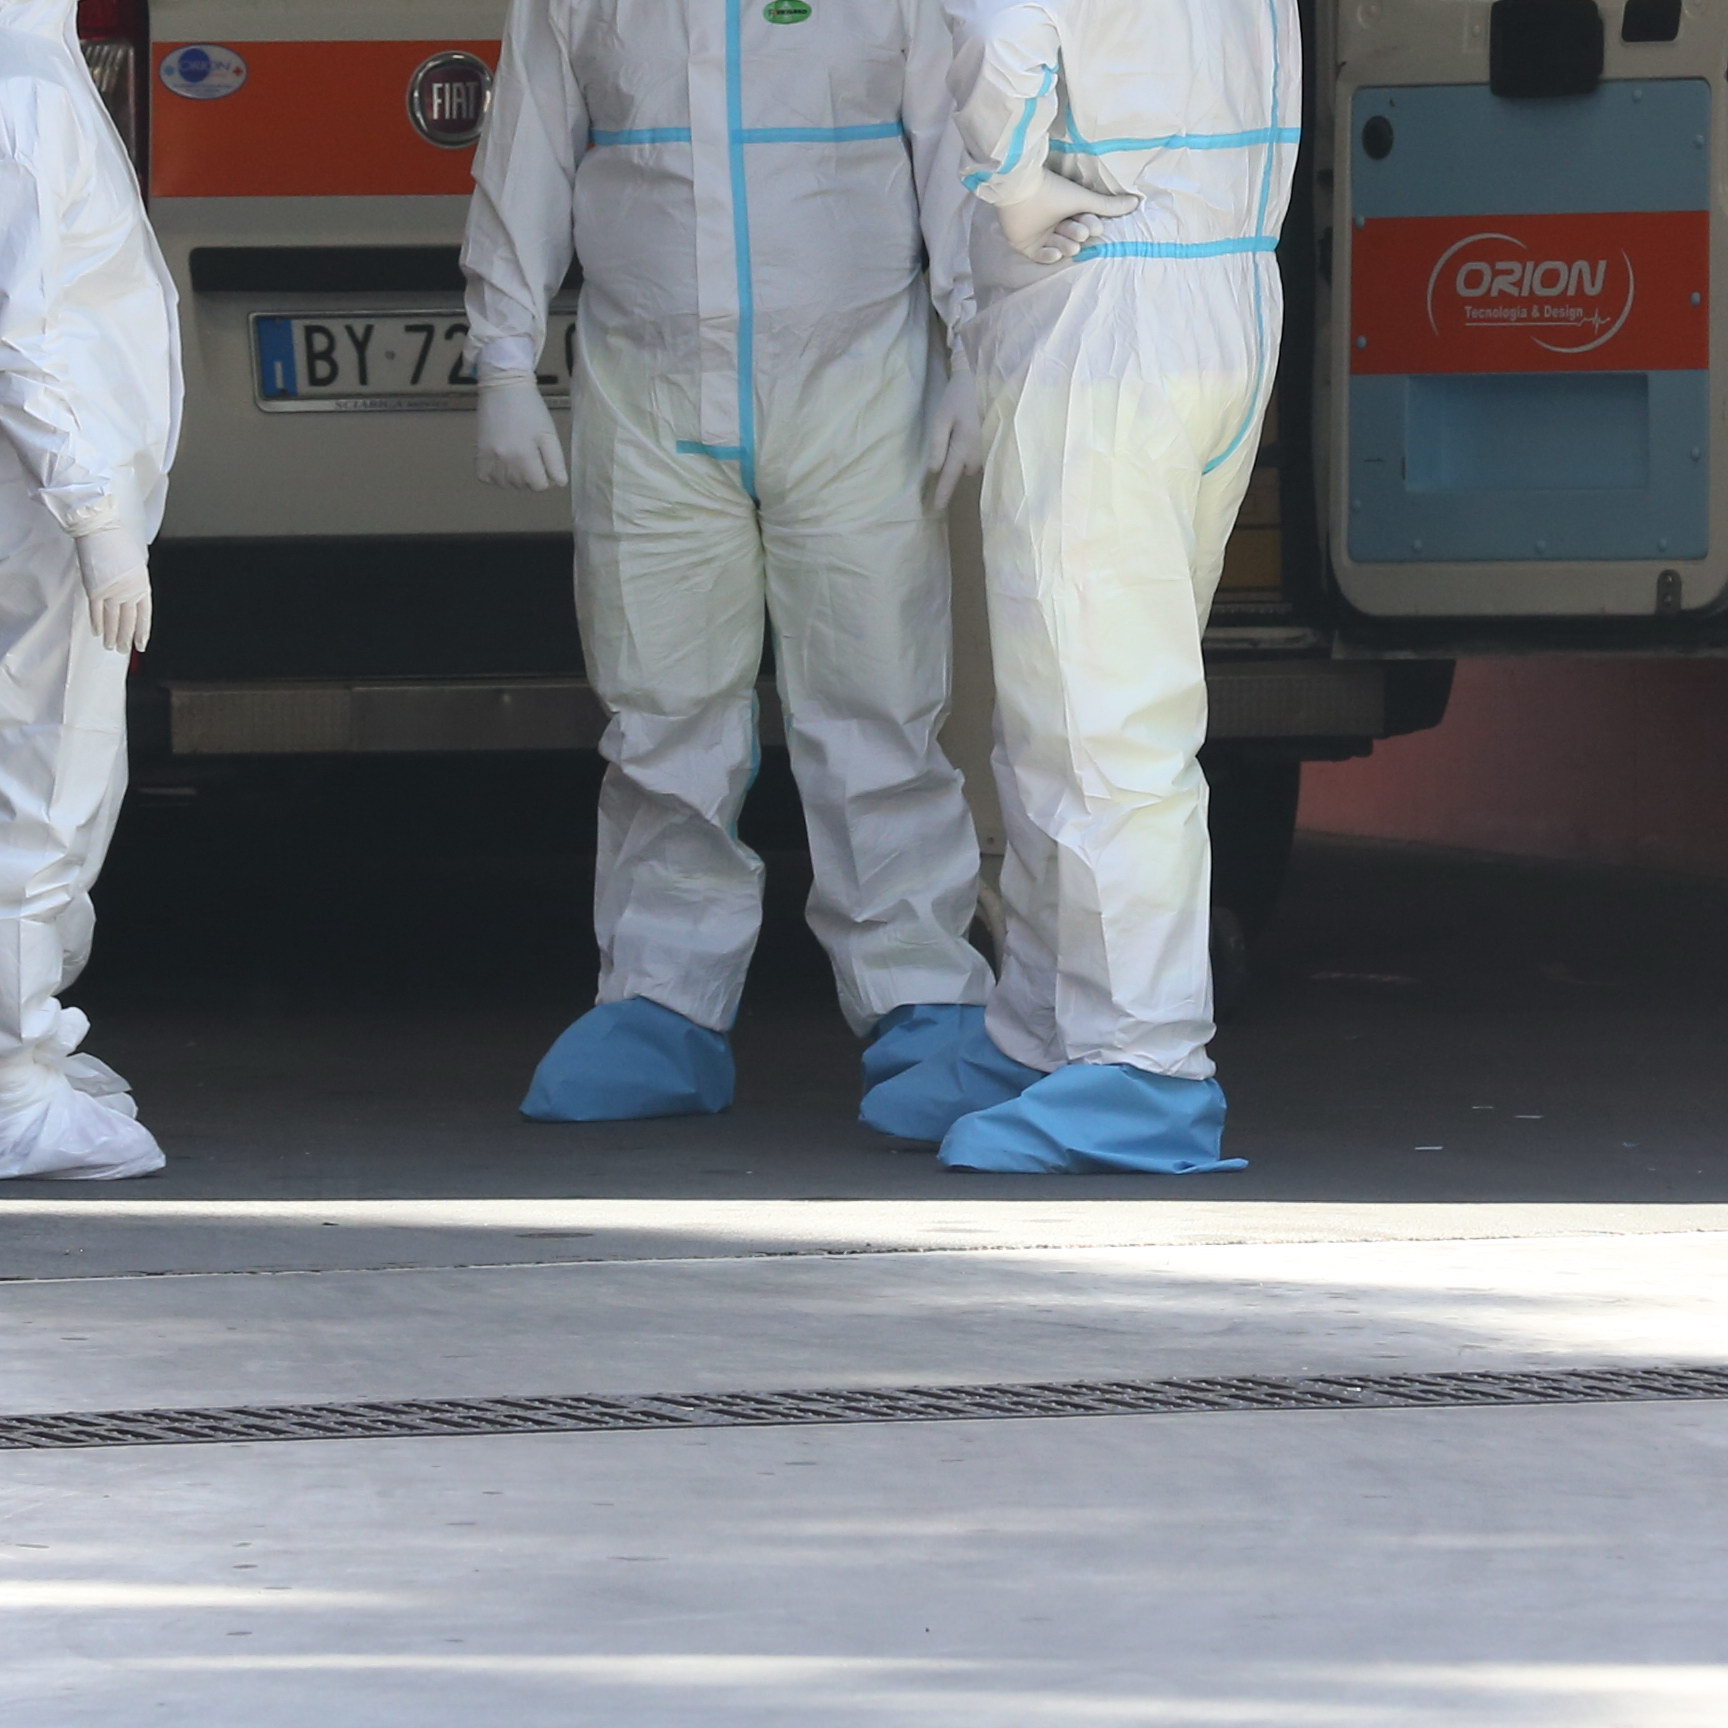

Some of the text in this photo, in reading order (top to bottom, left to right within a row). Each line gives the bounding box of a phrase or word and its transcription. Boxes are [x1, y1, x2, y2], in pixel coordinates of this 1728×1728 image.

[431, 81, 480, 120] FIAT
[1455, 259, 1608, 297] ORION
[1464, 304, 1584, 321] Tecnologia & Design
[303, 323, 375, 387] BY
[404, 323, 479, 386] 72
